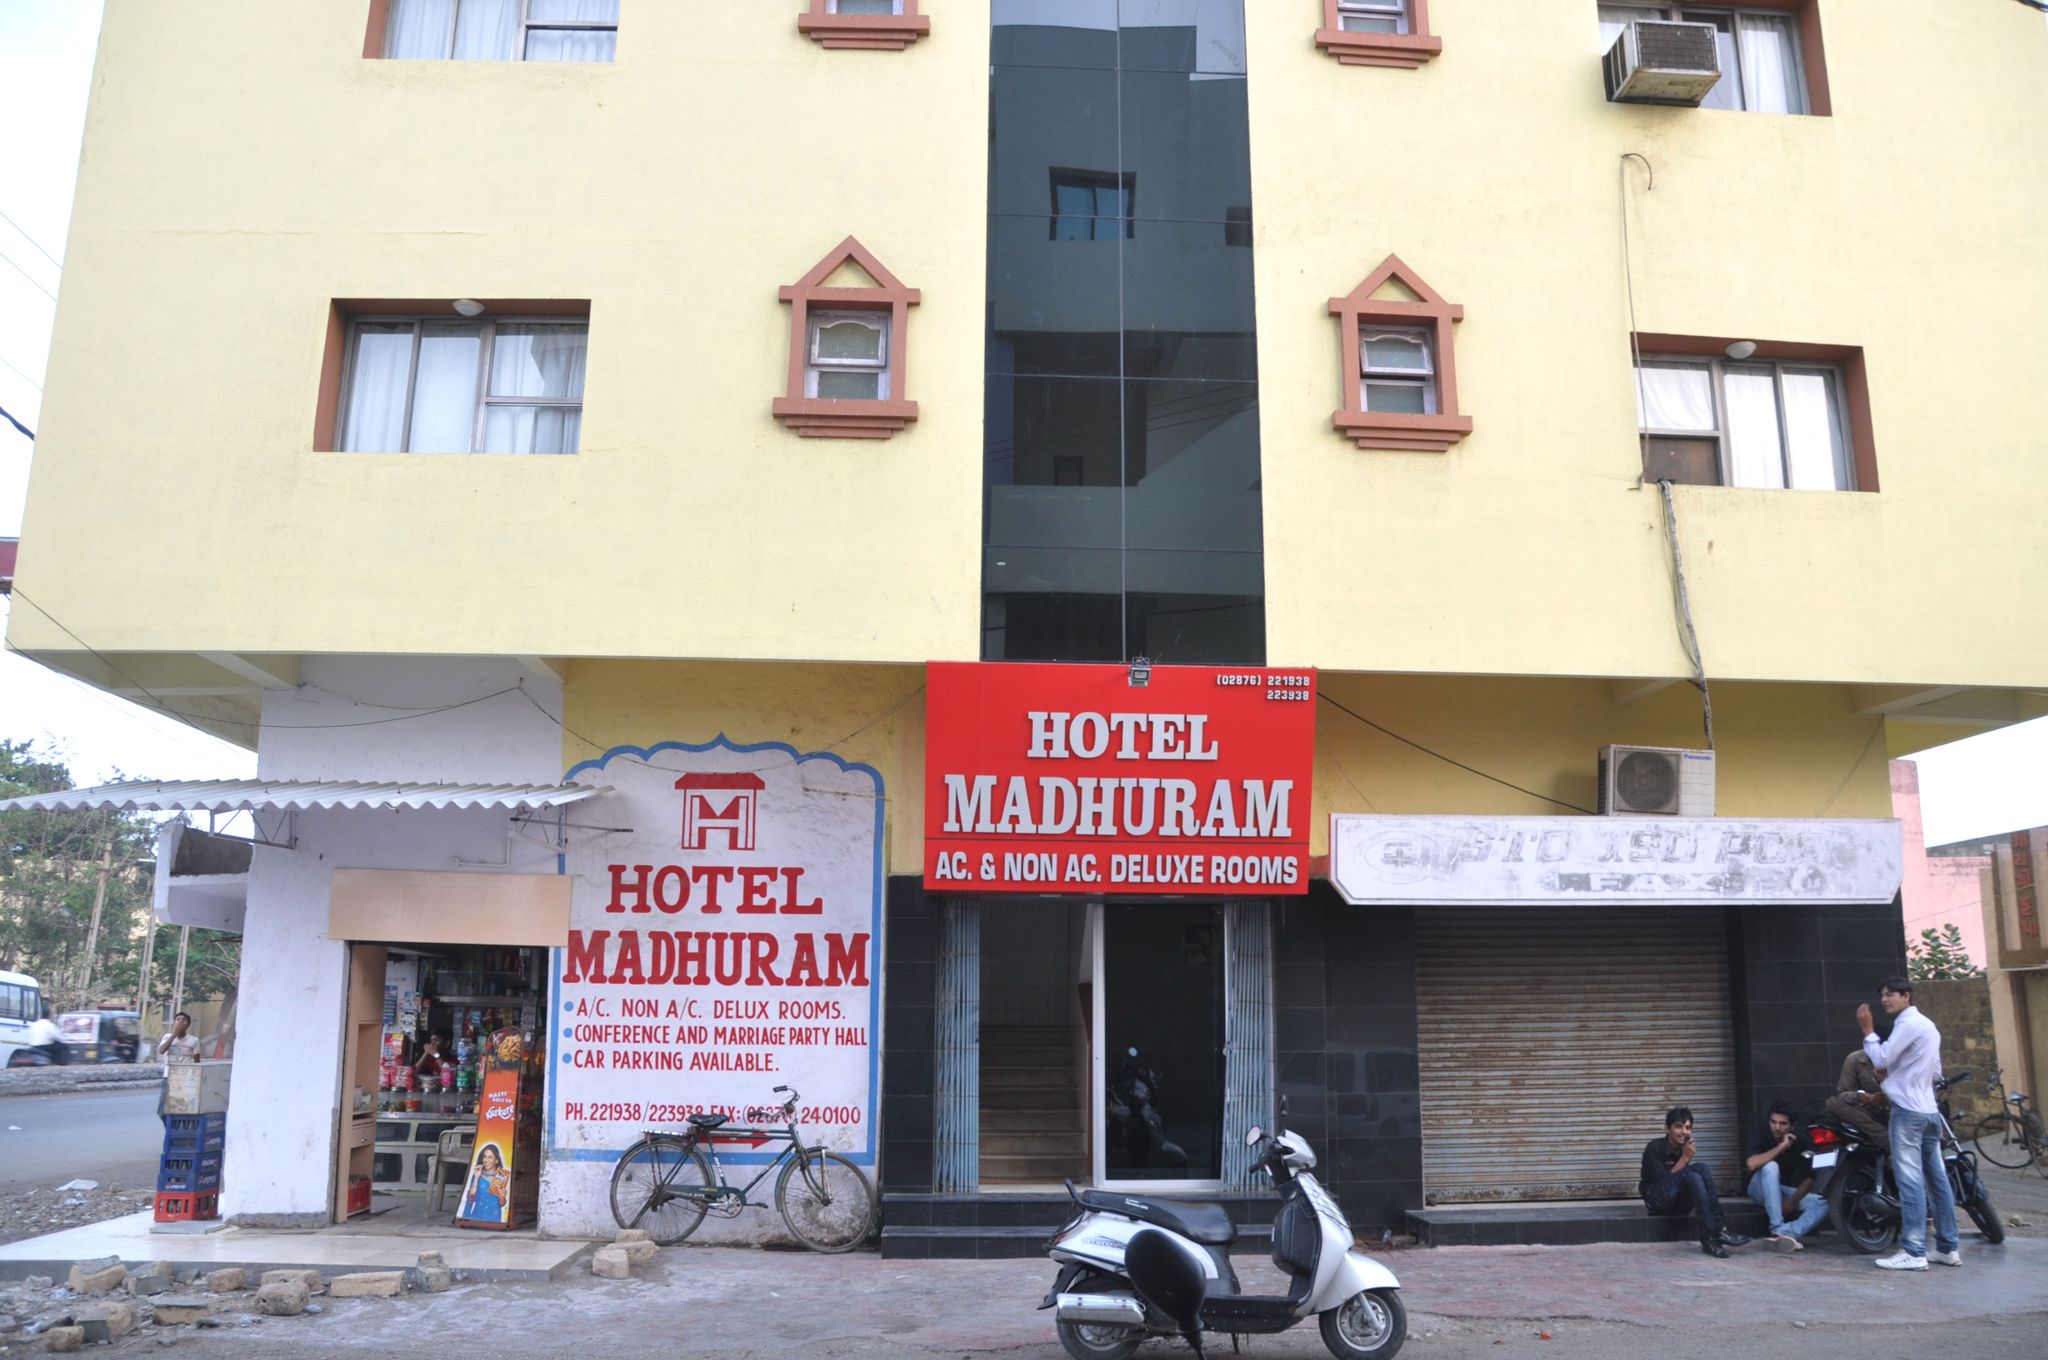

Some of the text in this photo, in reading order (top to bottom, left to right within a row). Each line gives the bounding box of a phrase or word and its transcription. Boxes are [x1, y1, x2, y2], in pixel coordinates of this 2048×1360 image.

[1217, 674, 1310, 686] (02876) 221938
[1267, 690, 1310, 701] 223938
[1027, 711, 1219, 761] HOTEL
[943, 774, 1294, 838] MADHURAM
[935, 851, 1298, 885] AC. & NON AC. DELUXE ROOMS
[605, 864, 824, 915] HOTEL
[562, 929, 871, 988] MADHURAM
[577, 996, 846, 1021] A/C. NON A/C. DELUX ROOMS.
[574, 1024, 867, 1046] CONFERENCE AND MARRIAGE PARTY HALL
[573, 1049, 780, 1073] CAR PARKING AVAILABLE.
[800, 1106, 861, 1125] 240100
